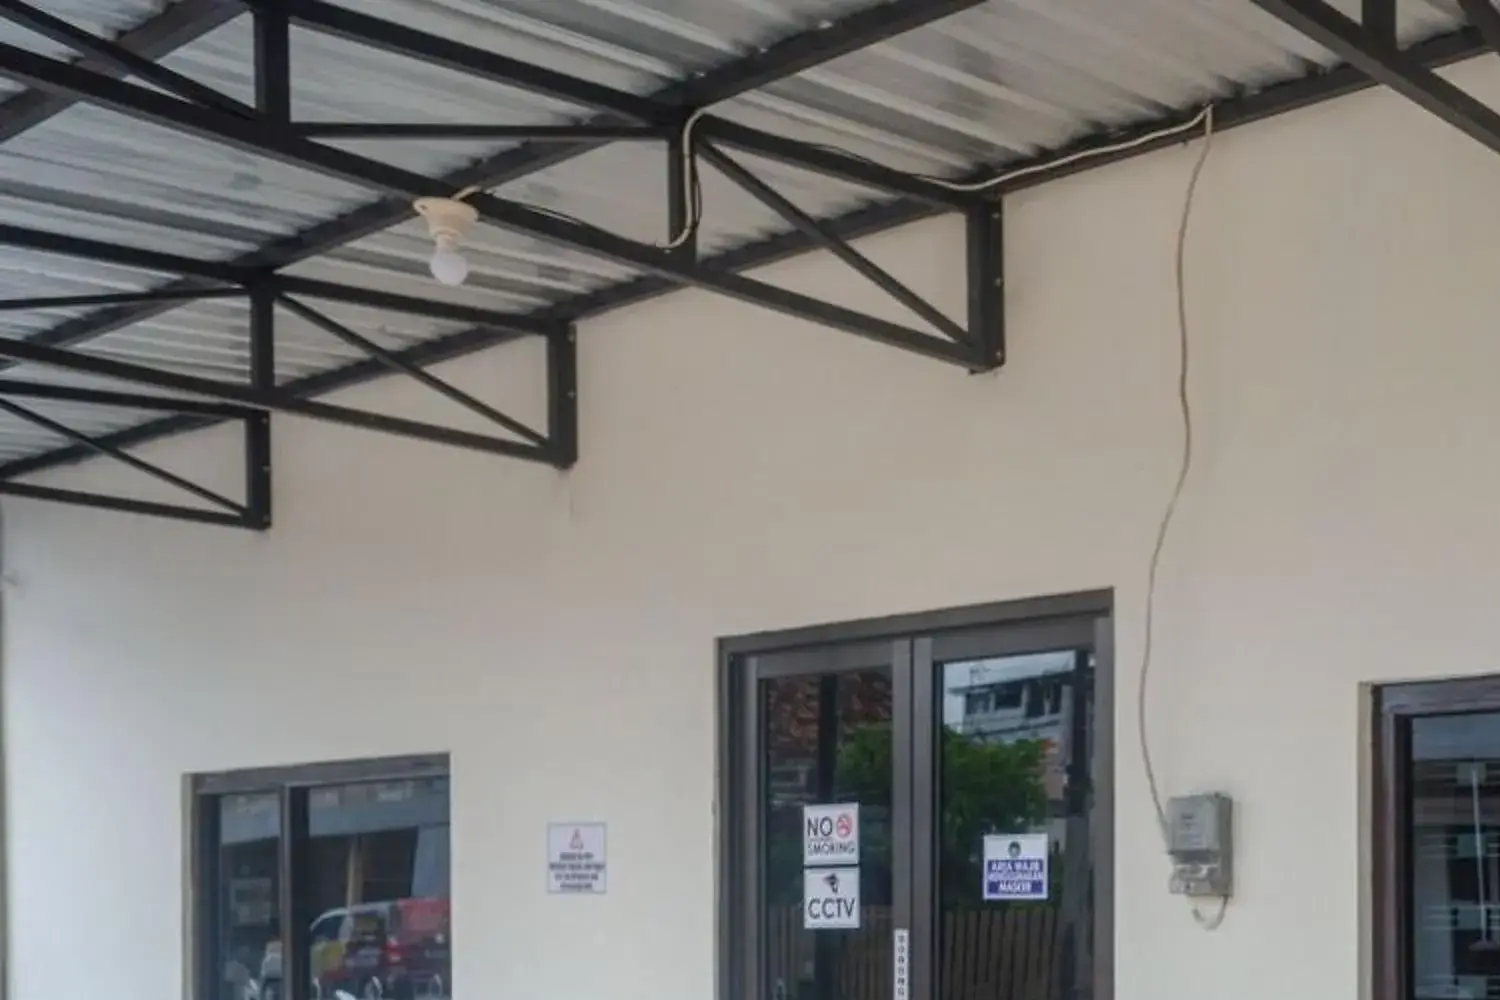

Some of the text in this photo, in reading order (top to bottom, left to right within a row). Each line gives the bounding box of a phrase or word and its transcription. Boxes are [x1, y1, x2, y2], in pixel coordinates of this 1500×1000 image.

[807, 816, 833, 837] NO
[807, 841, 856, 856] SMOKING
[807, 898, 856, 920] CCTV
